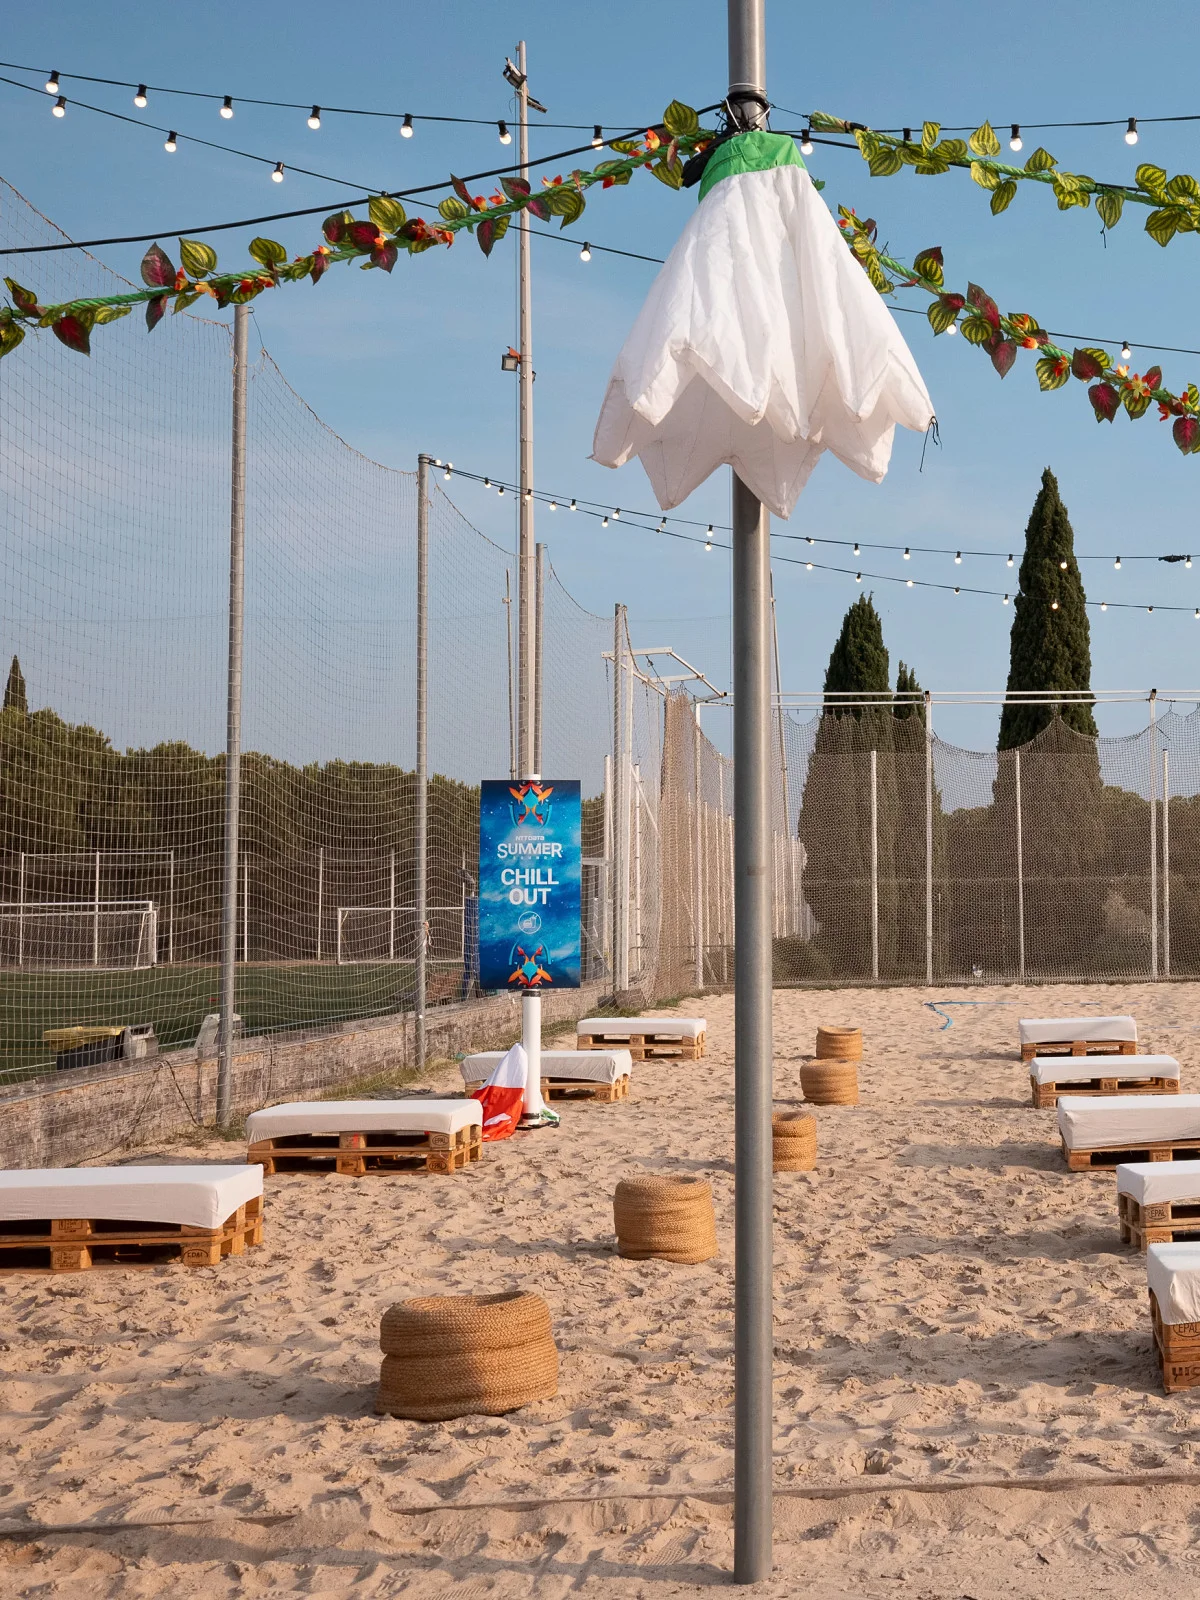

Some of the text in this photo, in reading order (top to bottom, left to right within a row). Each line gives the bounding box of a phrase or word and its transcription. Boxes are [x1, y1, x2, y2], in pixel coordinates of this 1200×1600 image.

[497, 842, 562, 859] SUMMER
[501, 868, 559, 885] CHILL
[509, 887, 551, 905] OUT
[1178, 1323, 1200, 1333] EPAL
